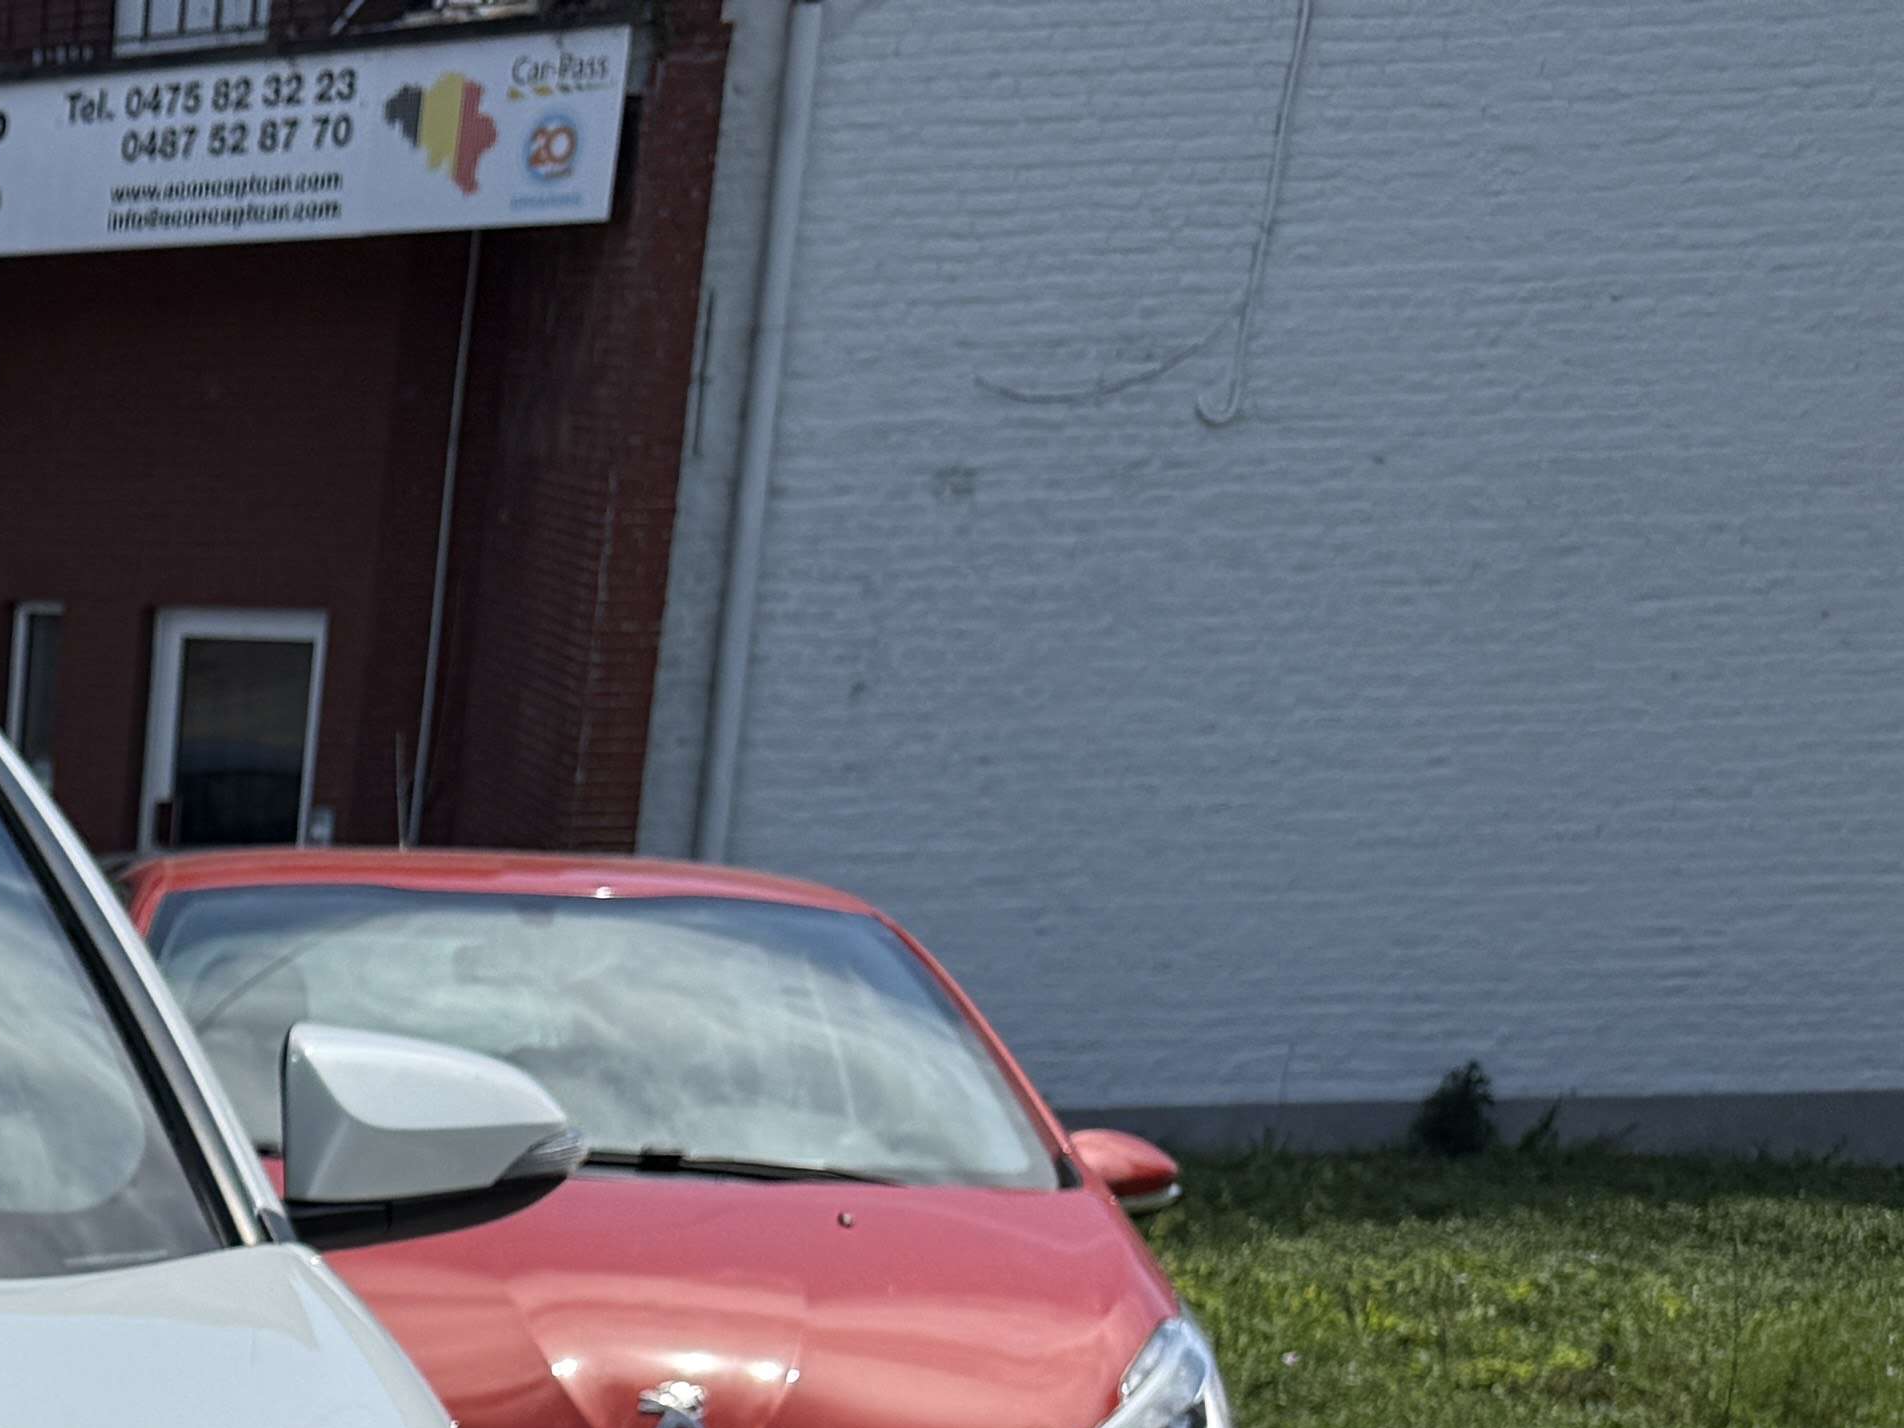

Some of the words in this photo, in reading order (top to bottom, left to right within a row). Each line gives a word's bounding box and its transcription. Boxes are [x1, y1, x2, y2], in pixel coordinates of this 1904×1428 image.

[66, 88, 114, 124] Tel.
[125, 79, 201, 119] 0475
[212, 76, 252, 112] 82
[262, 71, 304, 107] 32
[315, 68, 357, 104] 23
[121, 125, 197, 163] 0487
[208, 120, 250, 156] 52
[258, 117, 300, 151] 87
[313, 114, 354, 150] 70
